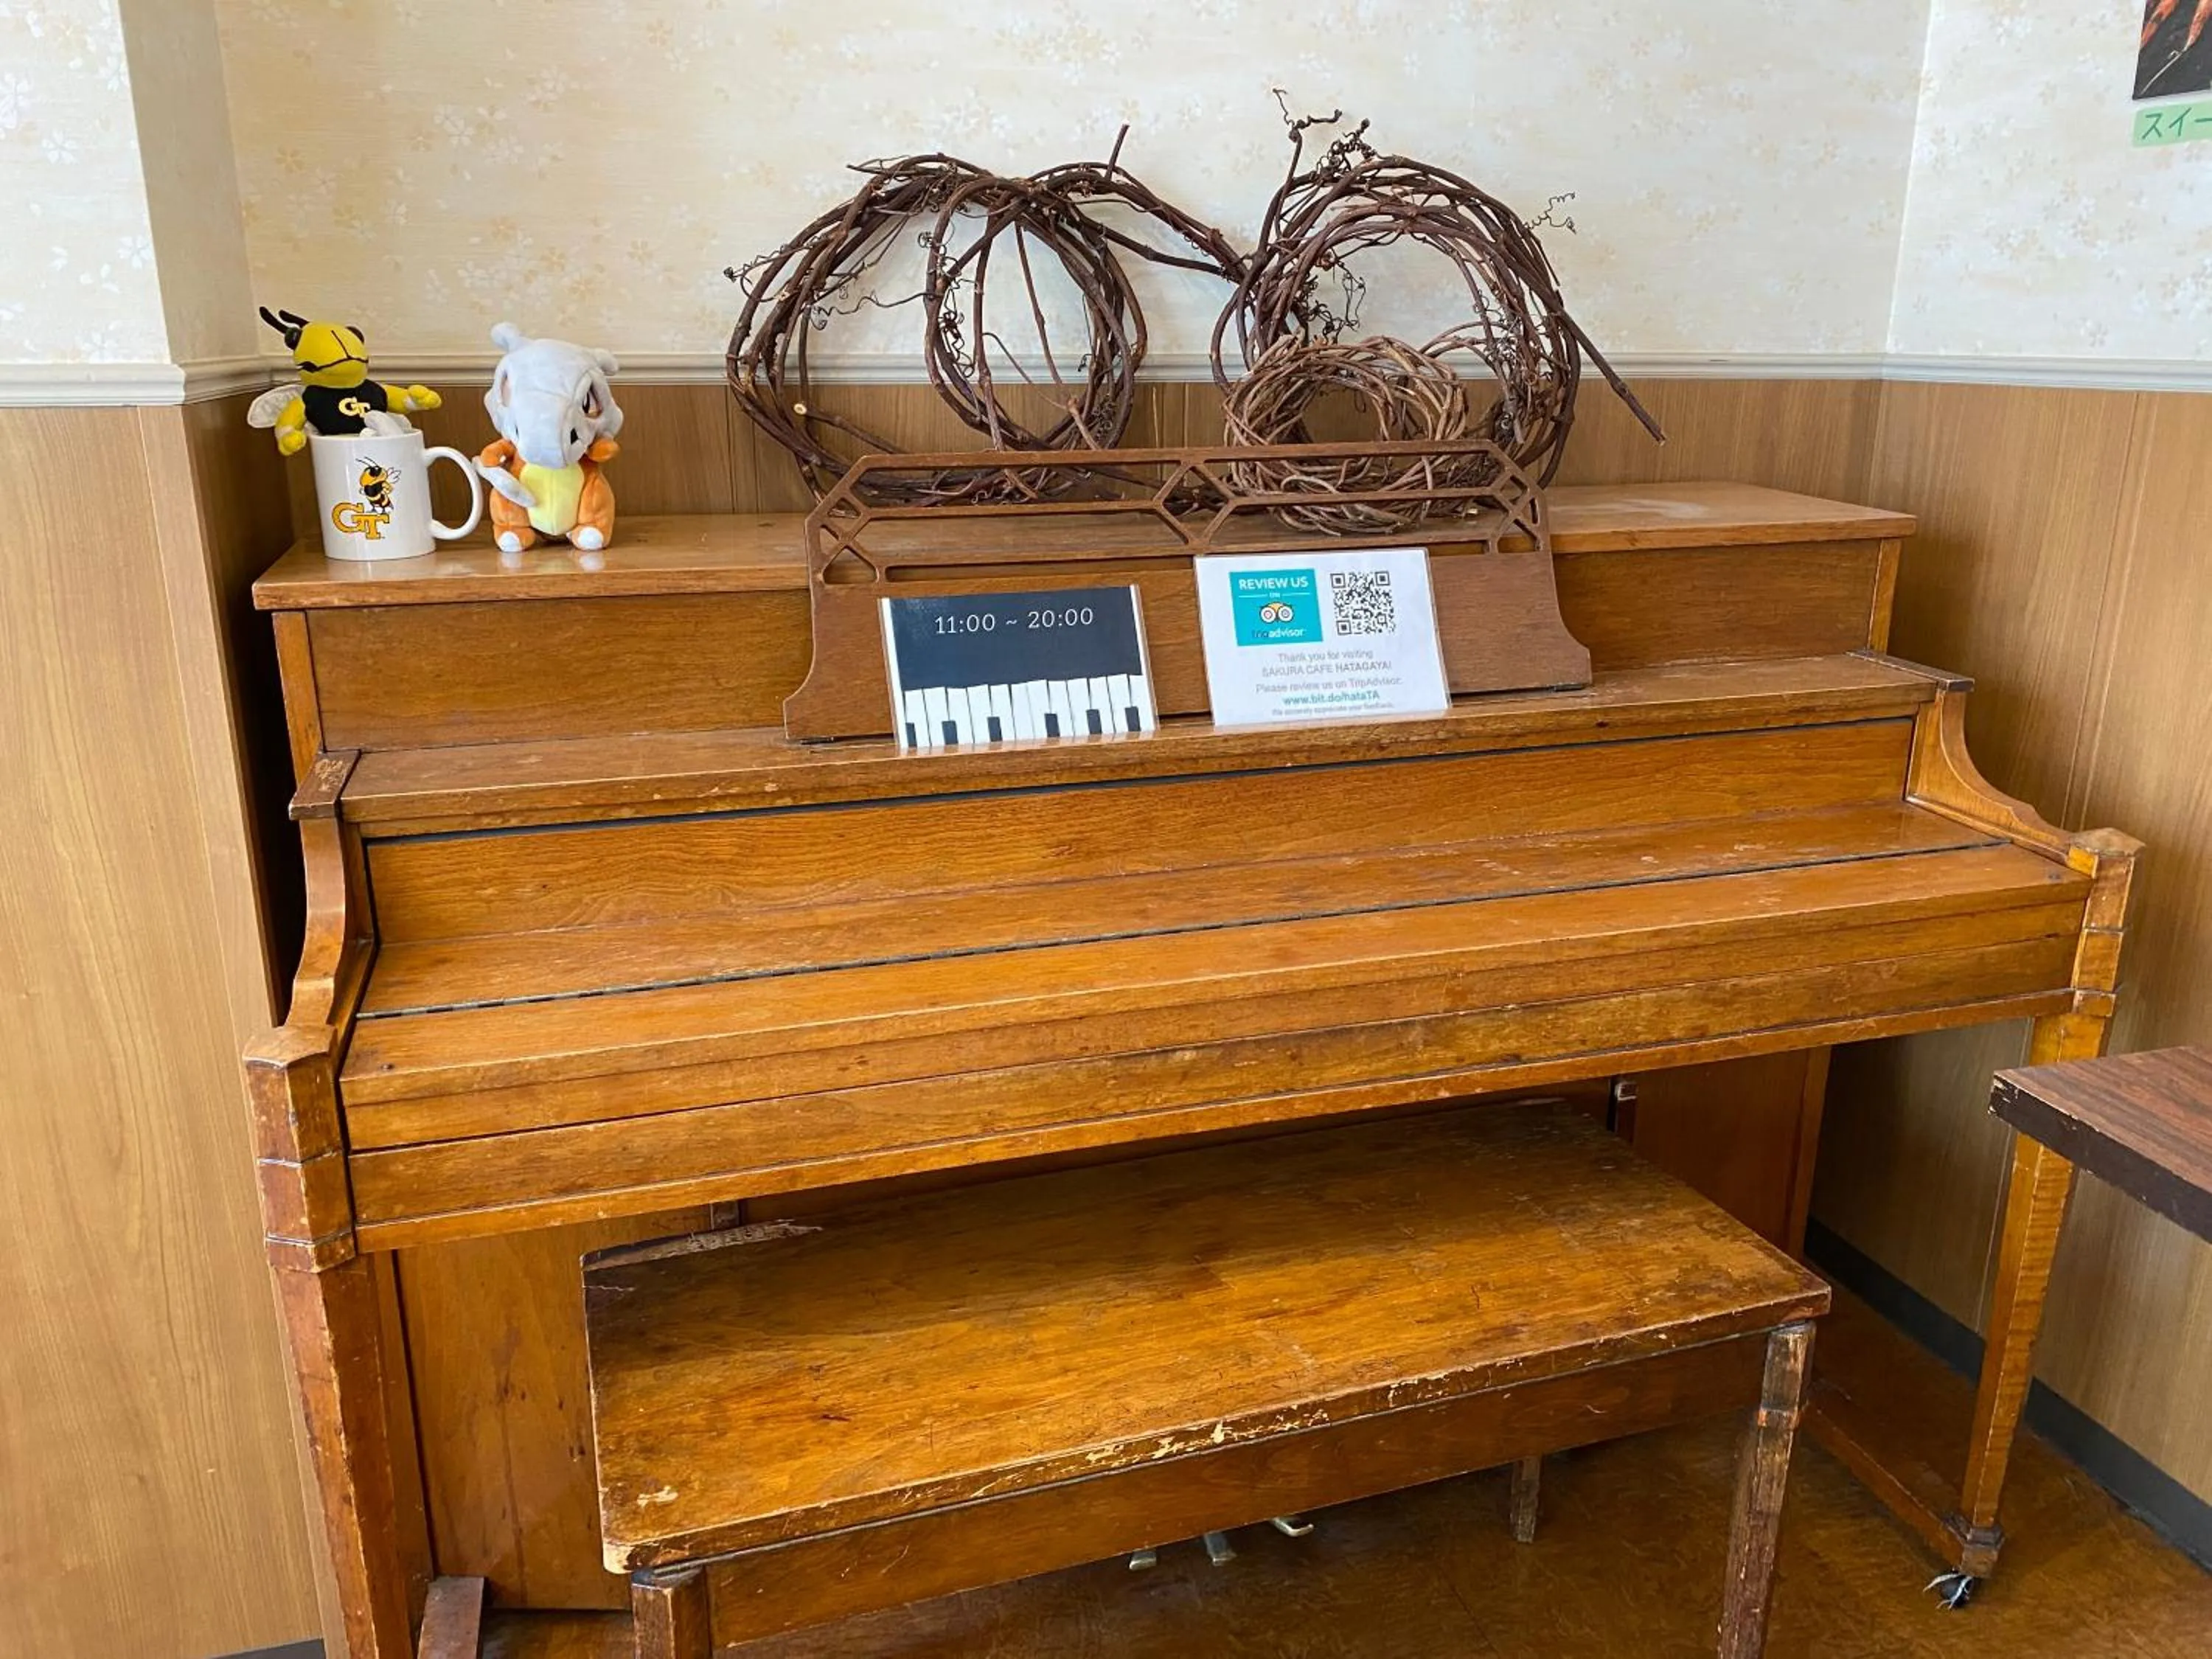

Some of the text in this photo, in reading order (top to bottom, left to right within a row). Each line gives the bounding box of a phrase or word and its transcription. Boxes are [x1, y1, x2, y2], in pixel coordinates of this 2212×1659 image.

[338, 397, 371, 418] GT
[332, 502, 390, 540] GT
[1239, 576, 1309, 590] REVIEW US
[935, 613, 995, 634] 11:00
[1028, 608, 1093, 630] 20:00
[1278, 649, 1374, 663] Thank you for visiting
[1262, 665, 1304, 677] SAKURA
[1306, 663, 1333, 675] CAFE
[1256, 683, 1287, 692] Please
[1290, 681, 1319, 691] review
[1322, 681, 1333, 689] us
[1335, 681, 1347, 689] on
